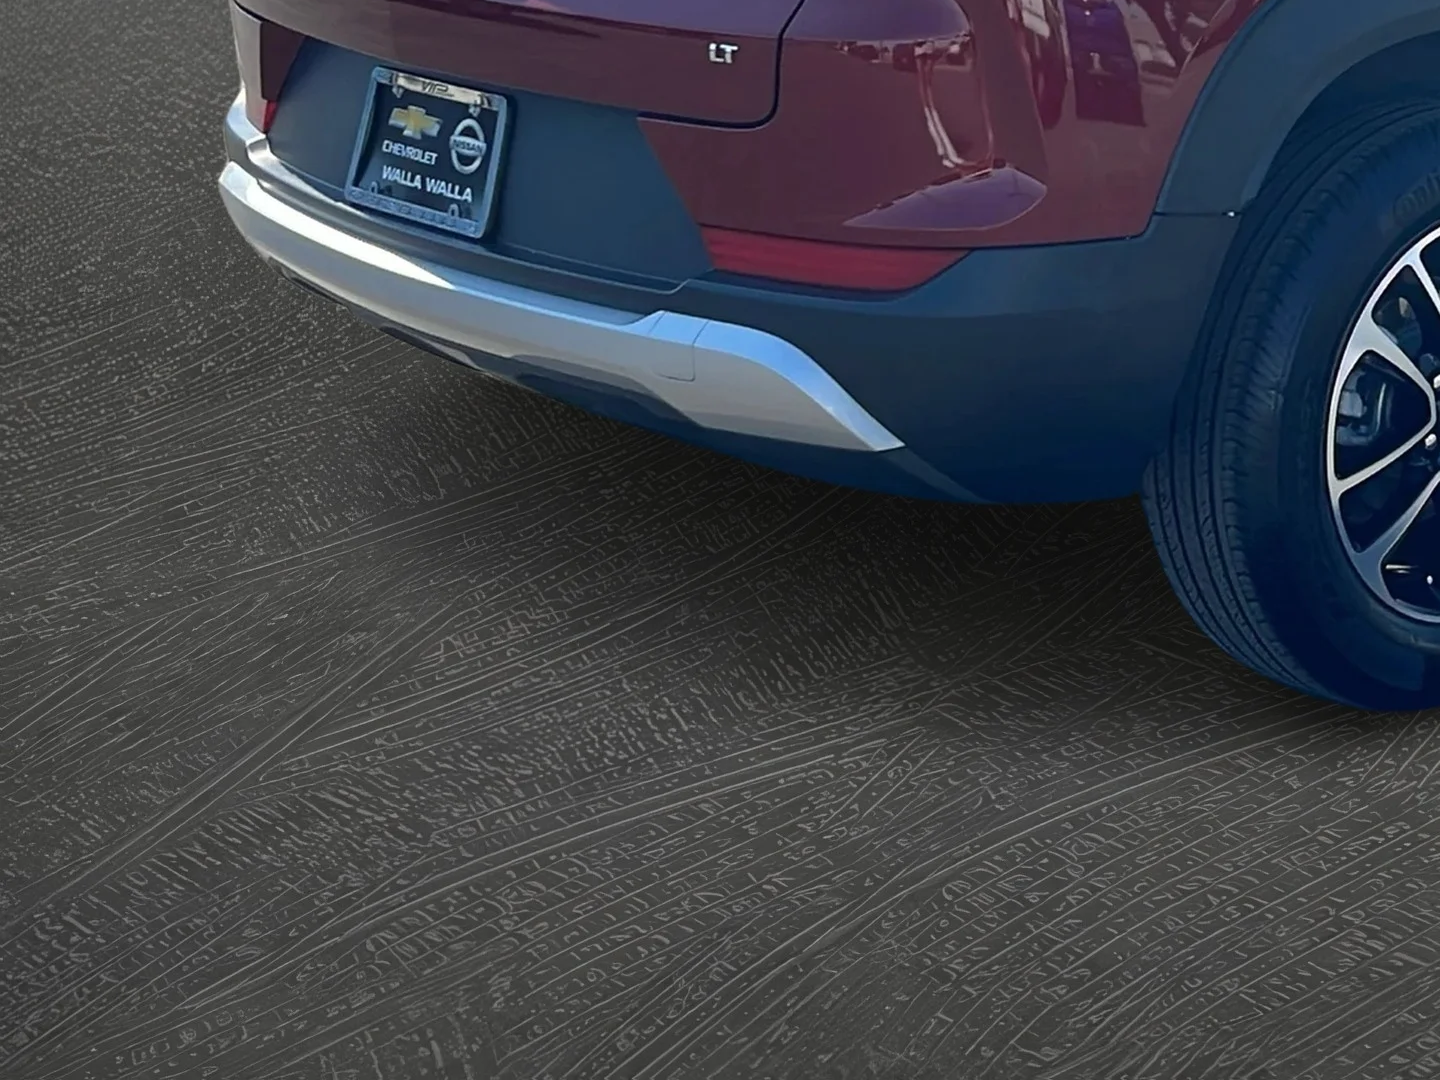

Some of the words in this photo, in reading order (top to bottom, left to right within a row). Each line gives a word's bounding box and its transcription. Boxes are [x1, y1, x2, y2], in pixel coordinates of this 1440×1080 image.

[709, 42, 739, 64] LT
[382, 140, 438, 164] CHEVROLET
[452, 138, 484, 154] NISSAN
[382, 165, 421, 189] WALLA
[426, 176, 472, 202] WALLA
